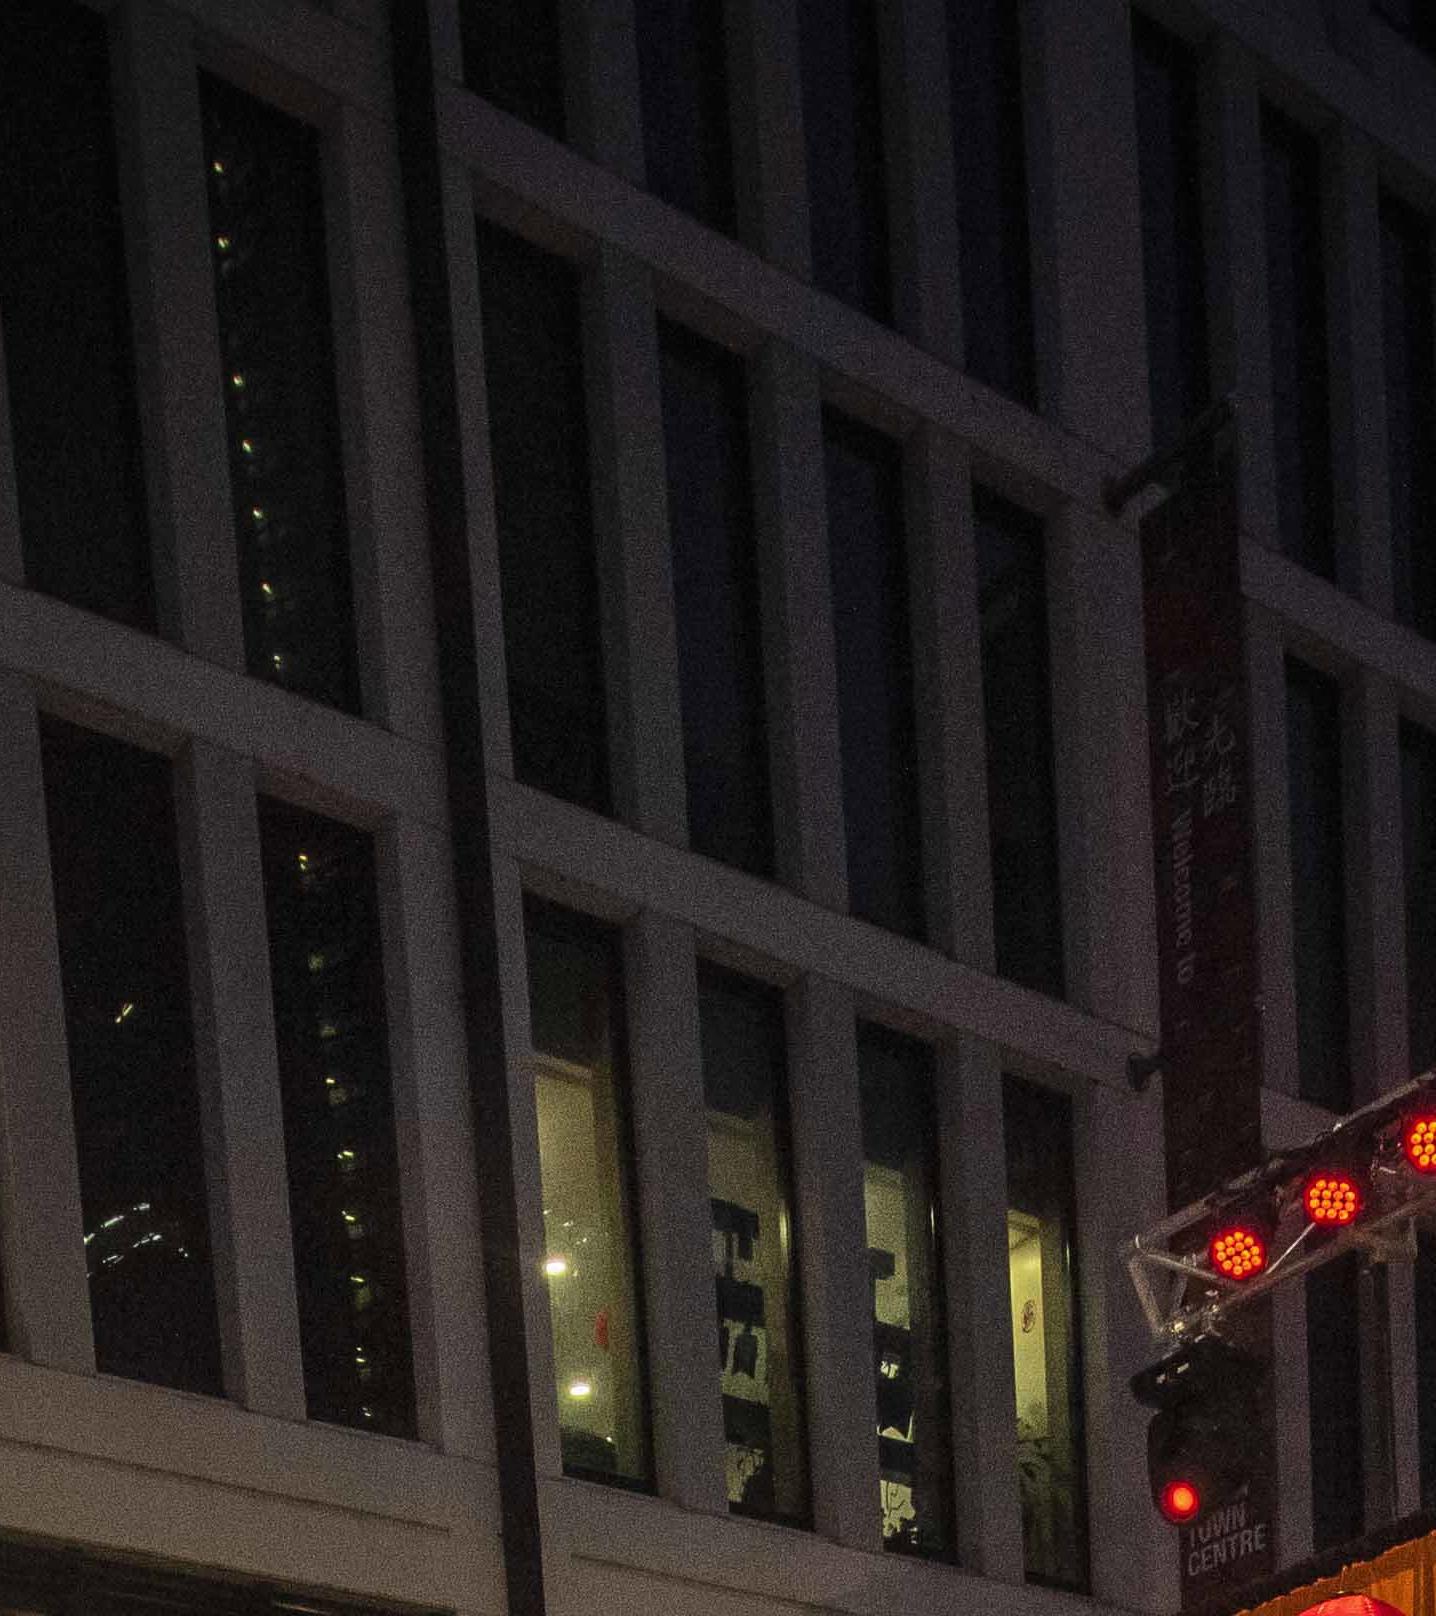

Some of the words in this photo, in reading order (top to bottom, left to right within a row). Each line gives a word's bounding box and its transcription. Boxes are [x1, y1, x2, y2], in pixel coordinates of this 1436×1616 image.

[1171, 808, 1193, 946] Welcome
[1176, 953, 1194, 985] to
[1188, 1523, 1267, 1577] CENTRE
